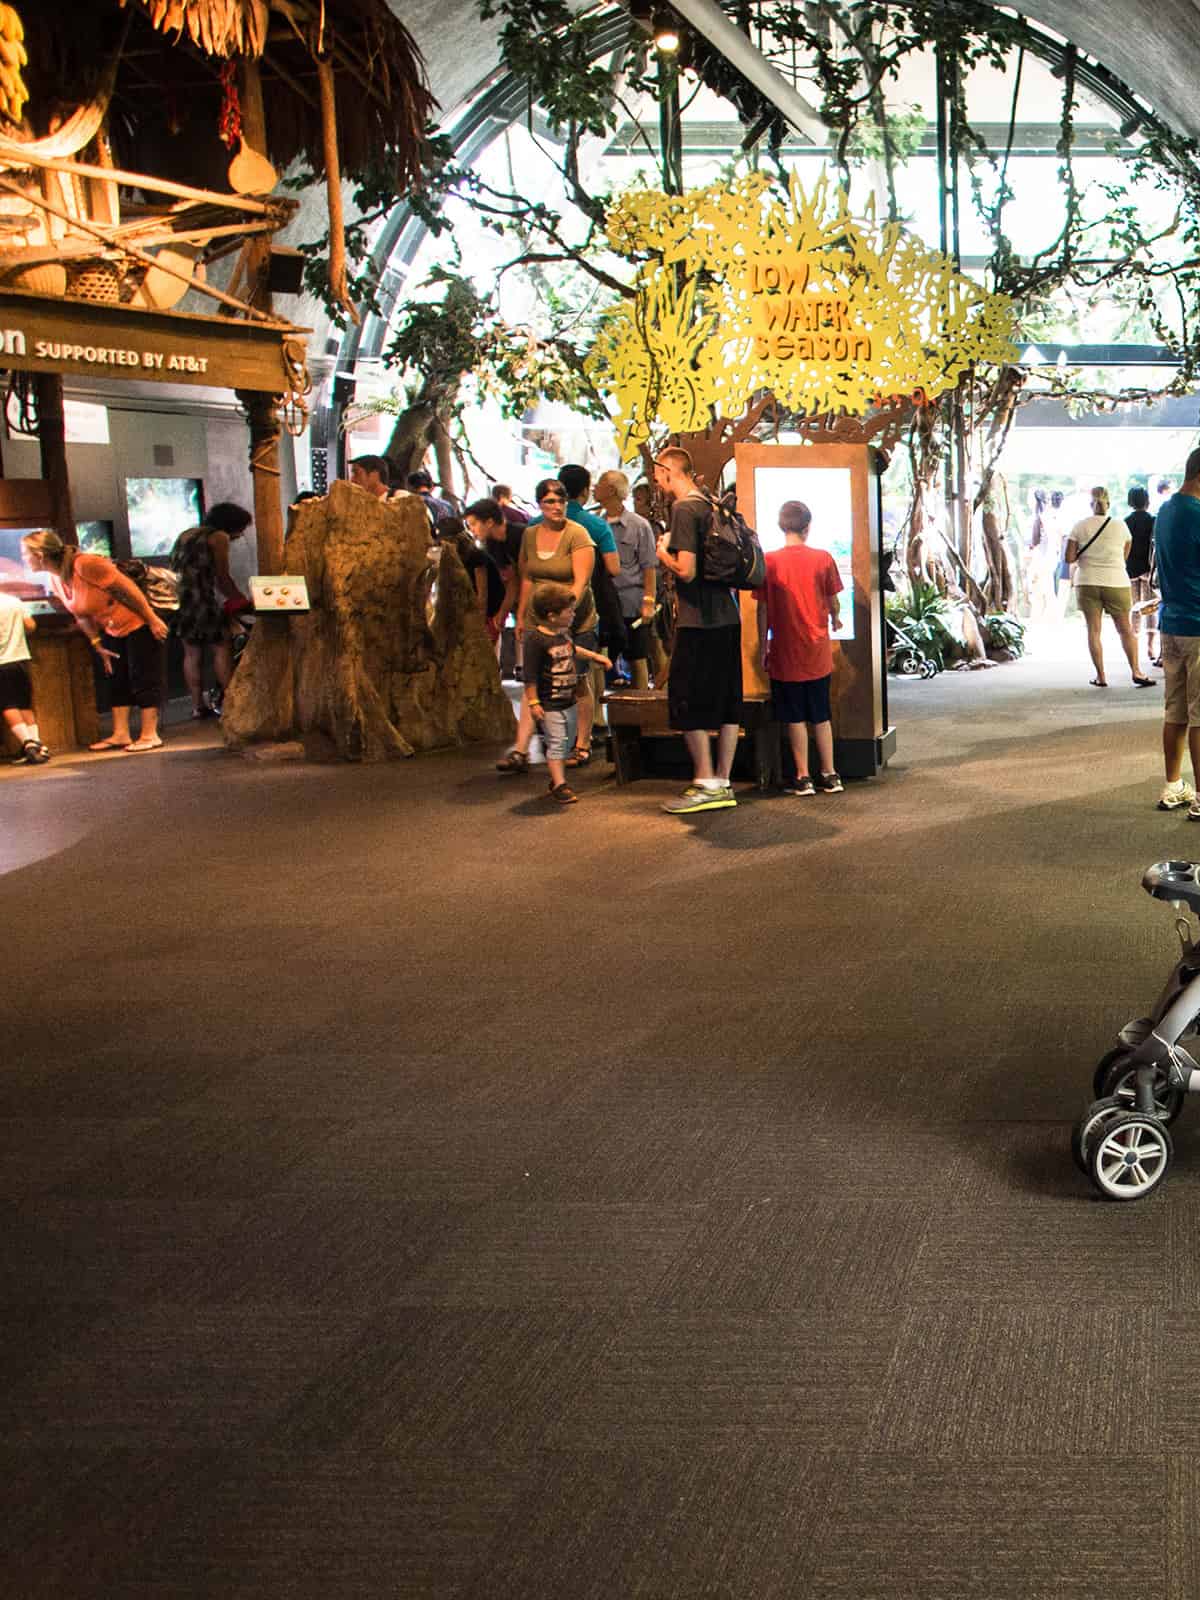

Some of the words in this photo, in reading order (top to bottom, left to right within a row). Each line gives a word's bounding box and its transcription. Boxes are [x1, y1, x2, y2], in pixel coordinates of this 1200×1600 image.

[751, 263, 809, 295] LOW
[763, 299, 852, 332] WATER
[0, 329, 26, 356] n
[35, 341, 140, 366] SUPPORTED
[143, 352, 164, 369] BY
[167, 355, 209, 373] AT&T
[755, 335, 872, 361] season
